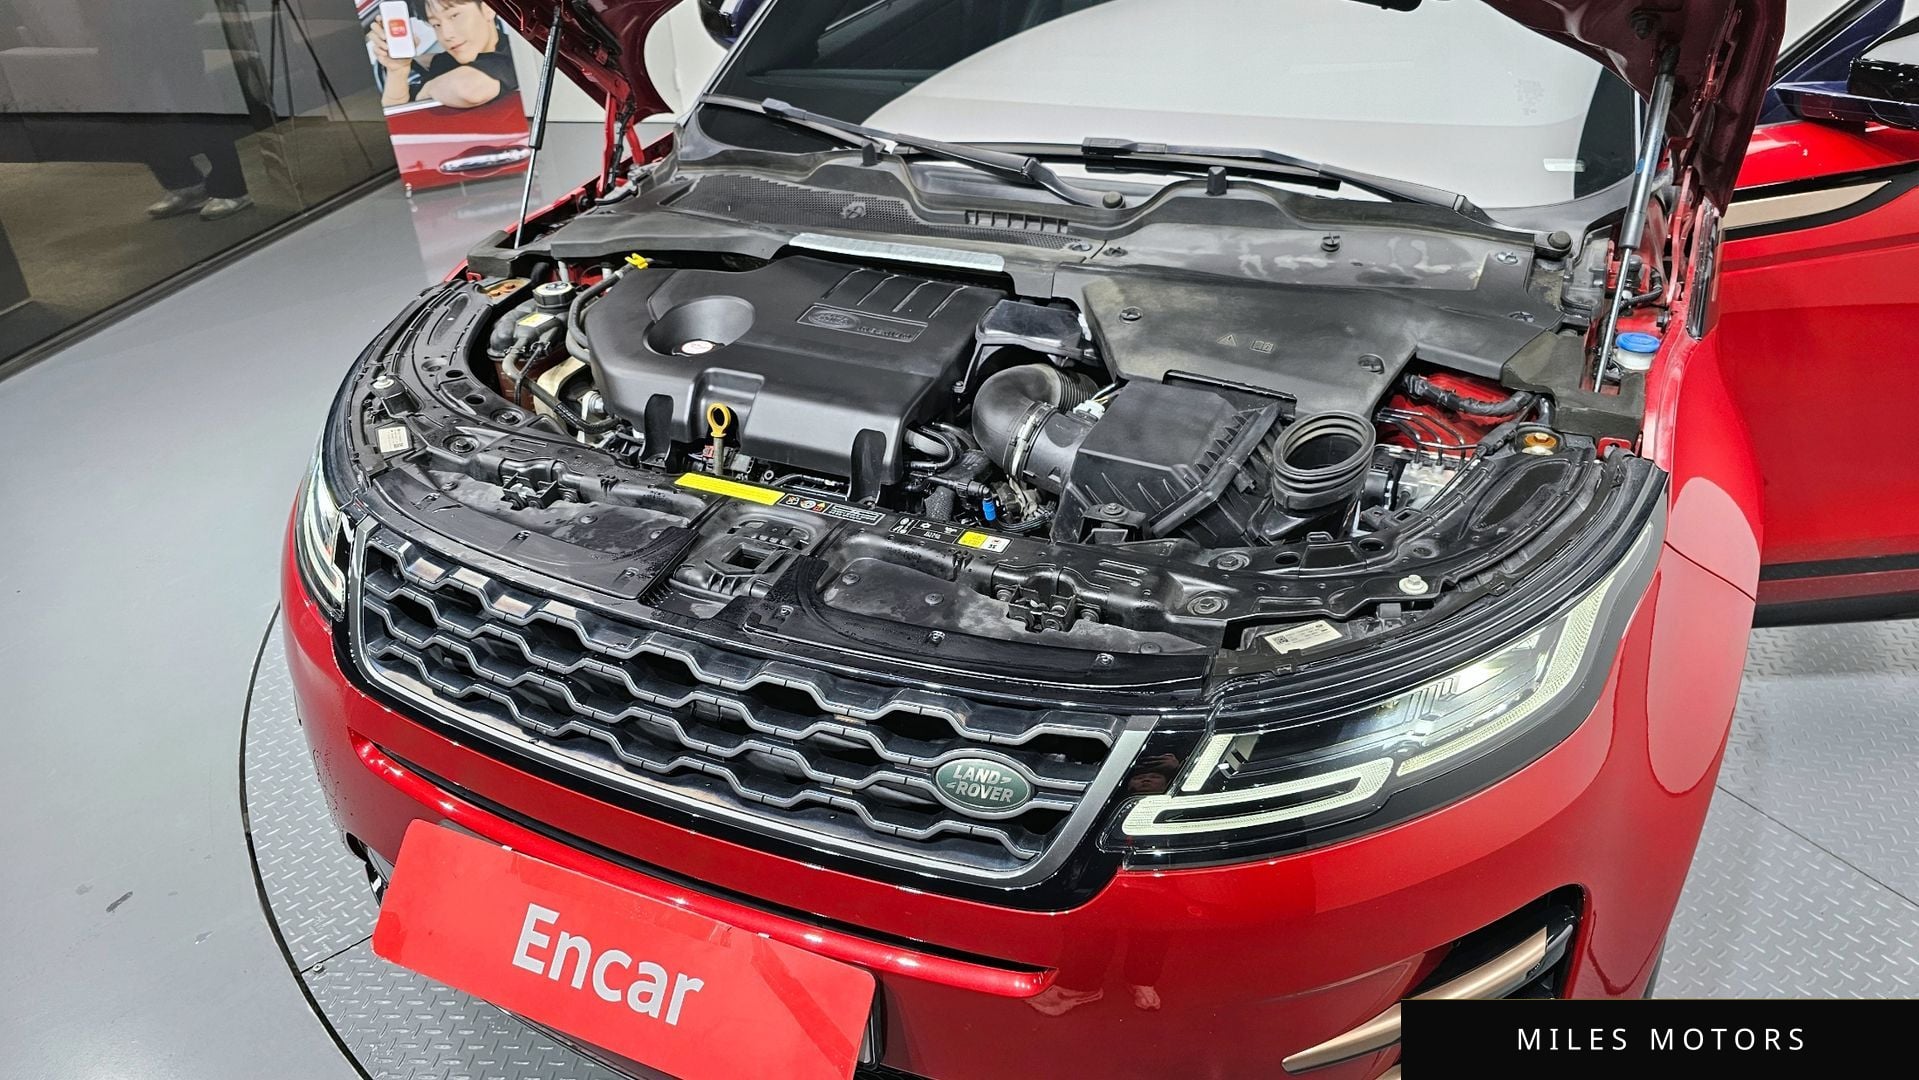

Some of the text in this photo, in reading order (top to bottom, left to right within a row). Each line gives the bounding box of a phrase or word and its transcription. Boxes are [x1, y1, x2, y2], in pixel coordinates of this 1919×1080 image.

[953, 764, 1001, 785] LAND
[955, 781, 1014, 803] ROVER
[512, 903, 704, 1026] Encar
